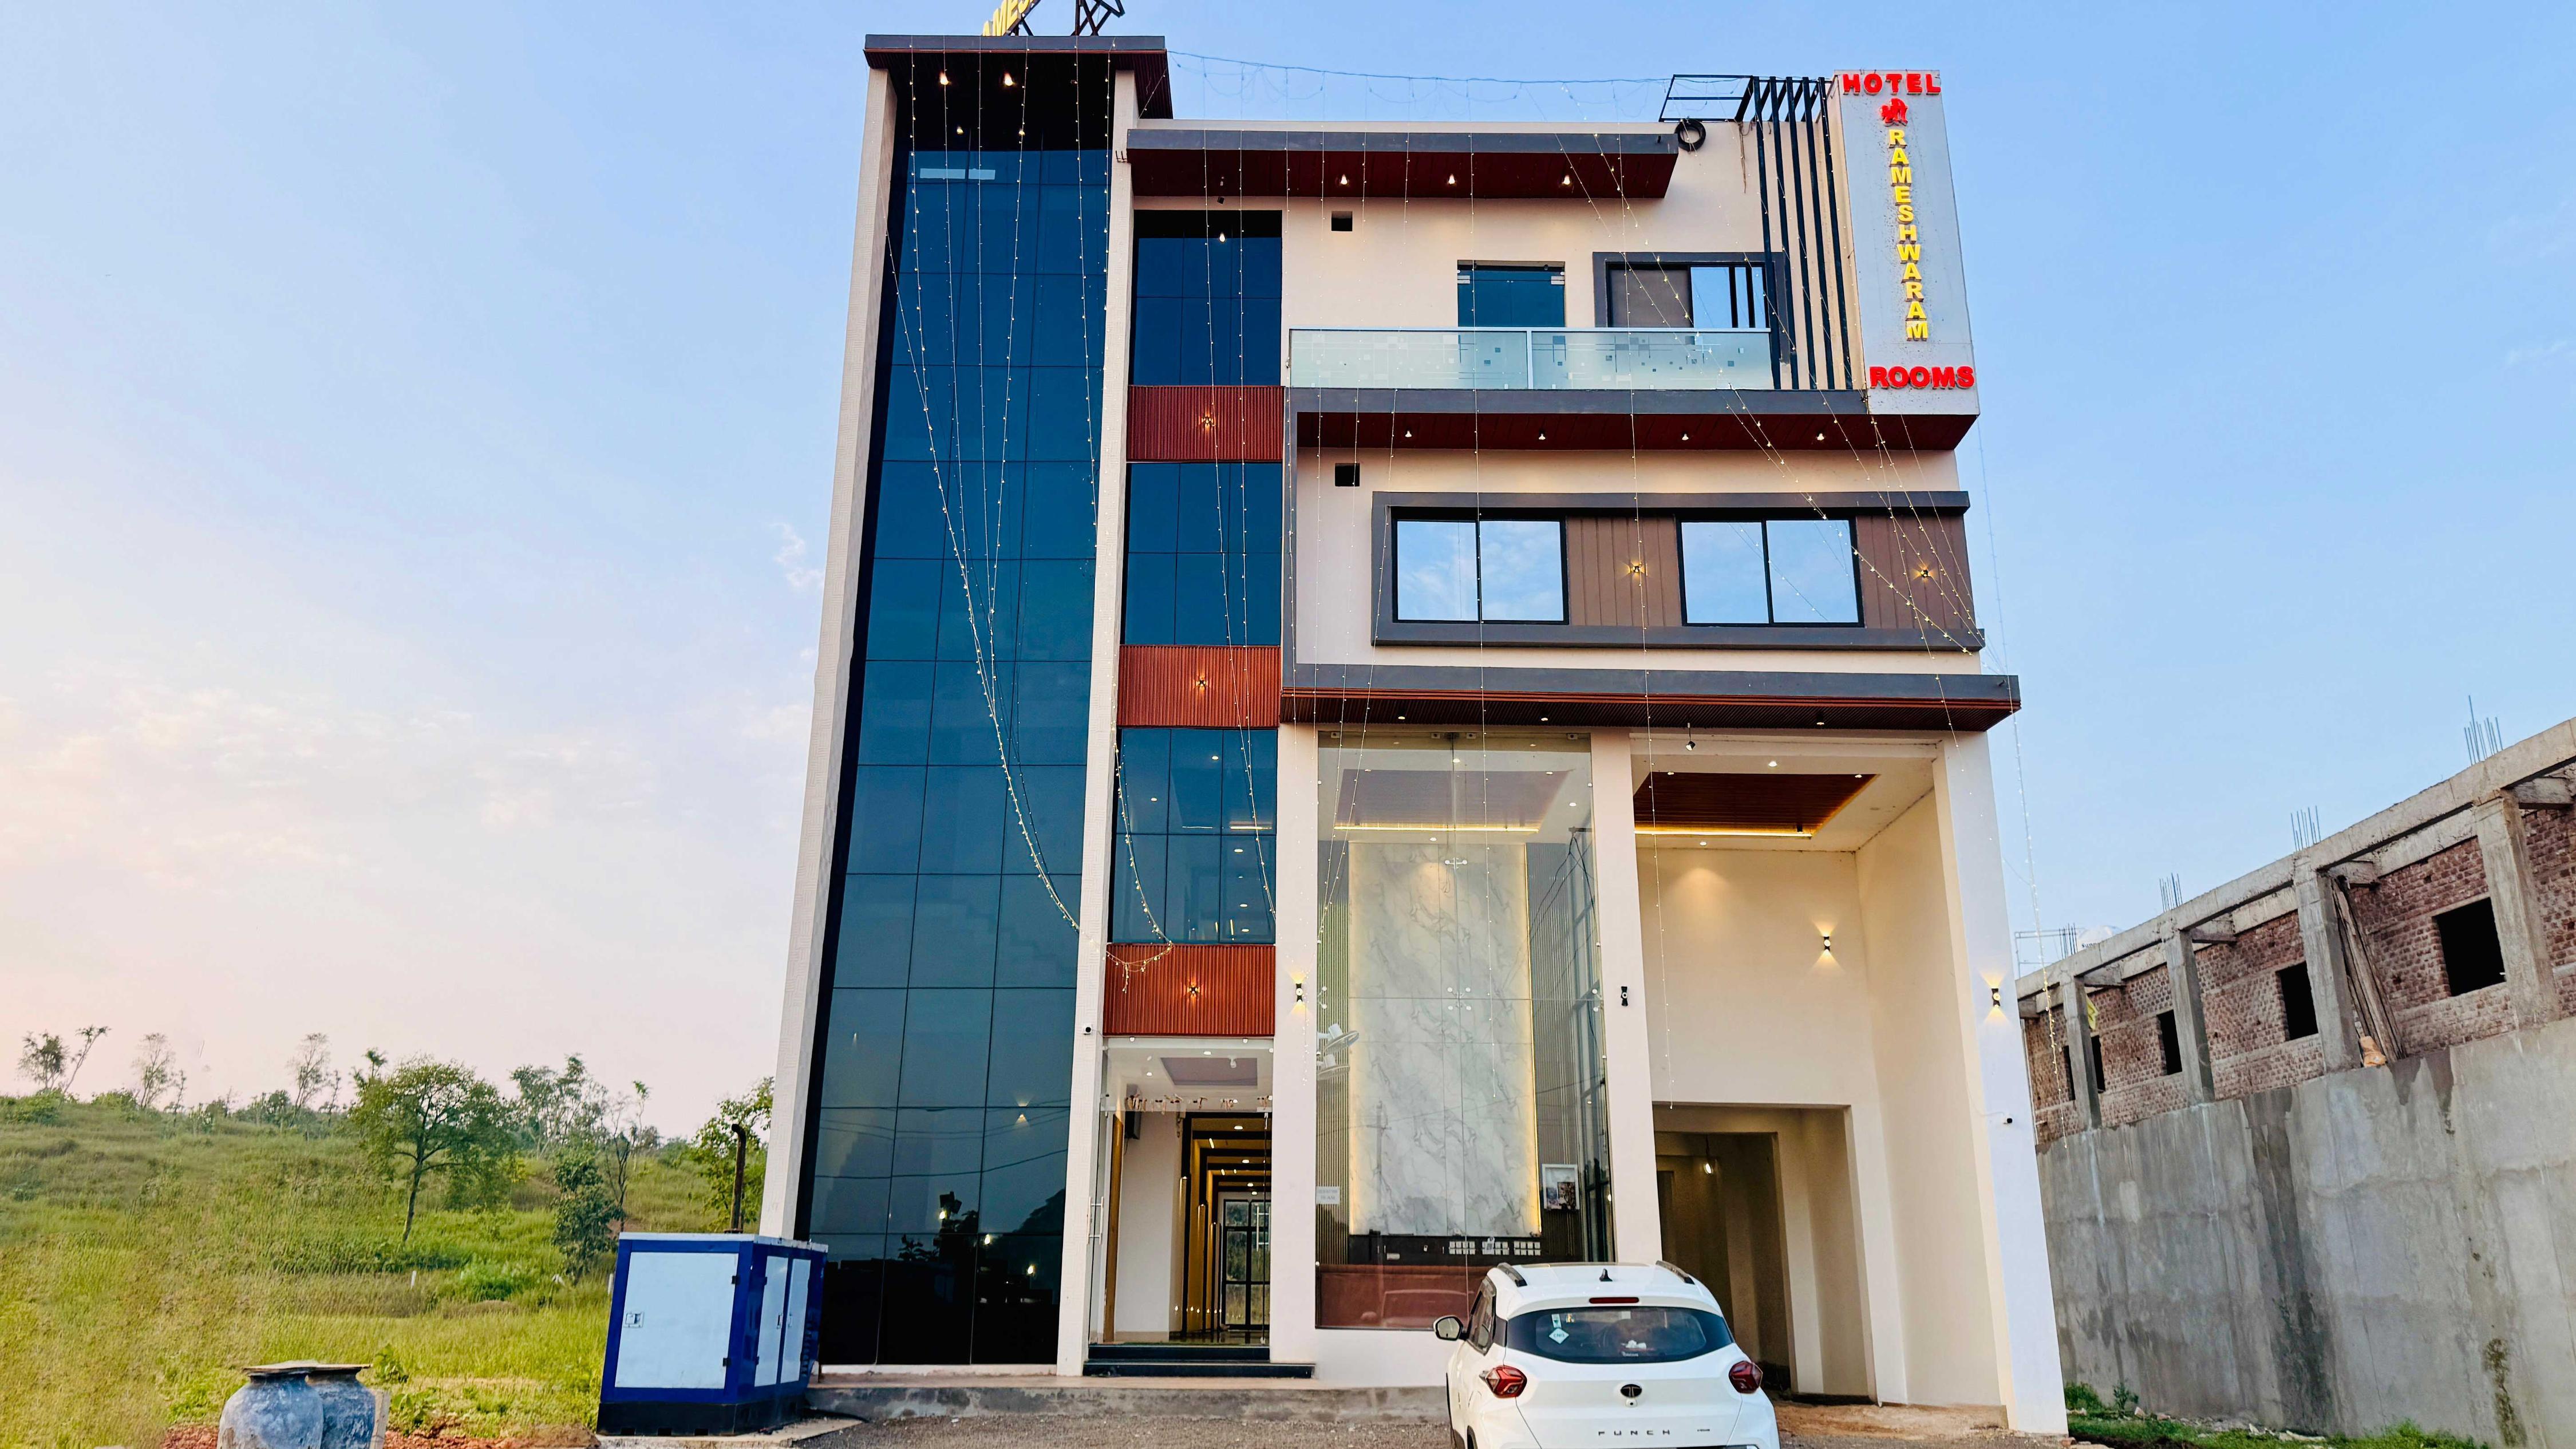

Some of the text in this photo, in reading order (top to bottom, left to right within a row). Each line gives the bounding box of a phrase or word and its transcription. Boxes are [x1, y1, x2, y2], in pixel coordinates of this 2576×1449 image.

[1843, 73, 1941, 95] HOTEL
[1888, 129, 1928, 341] RAMESHWARAM
[1869, 366, 1975, 389] ROOMS
